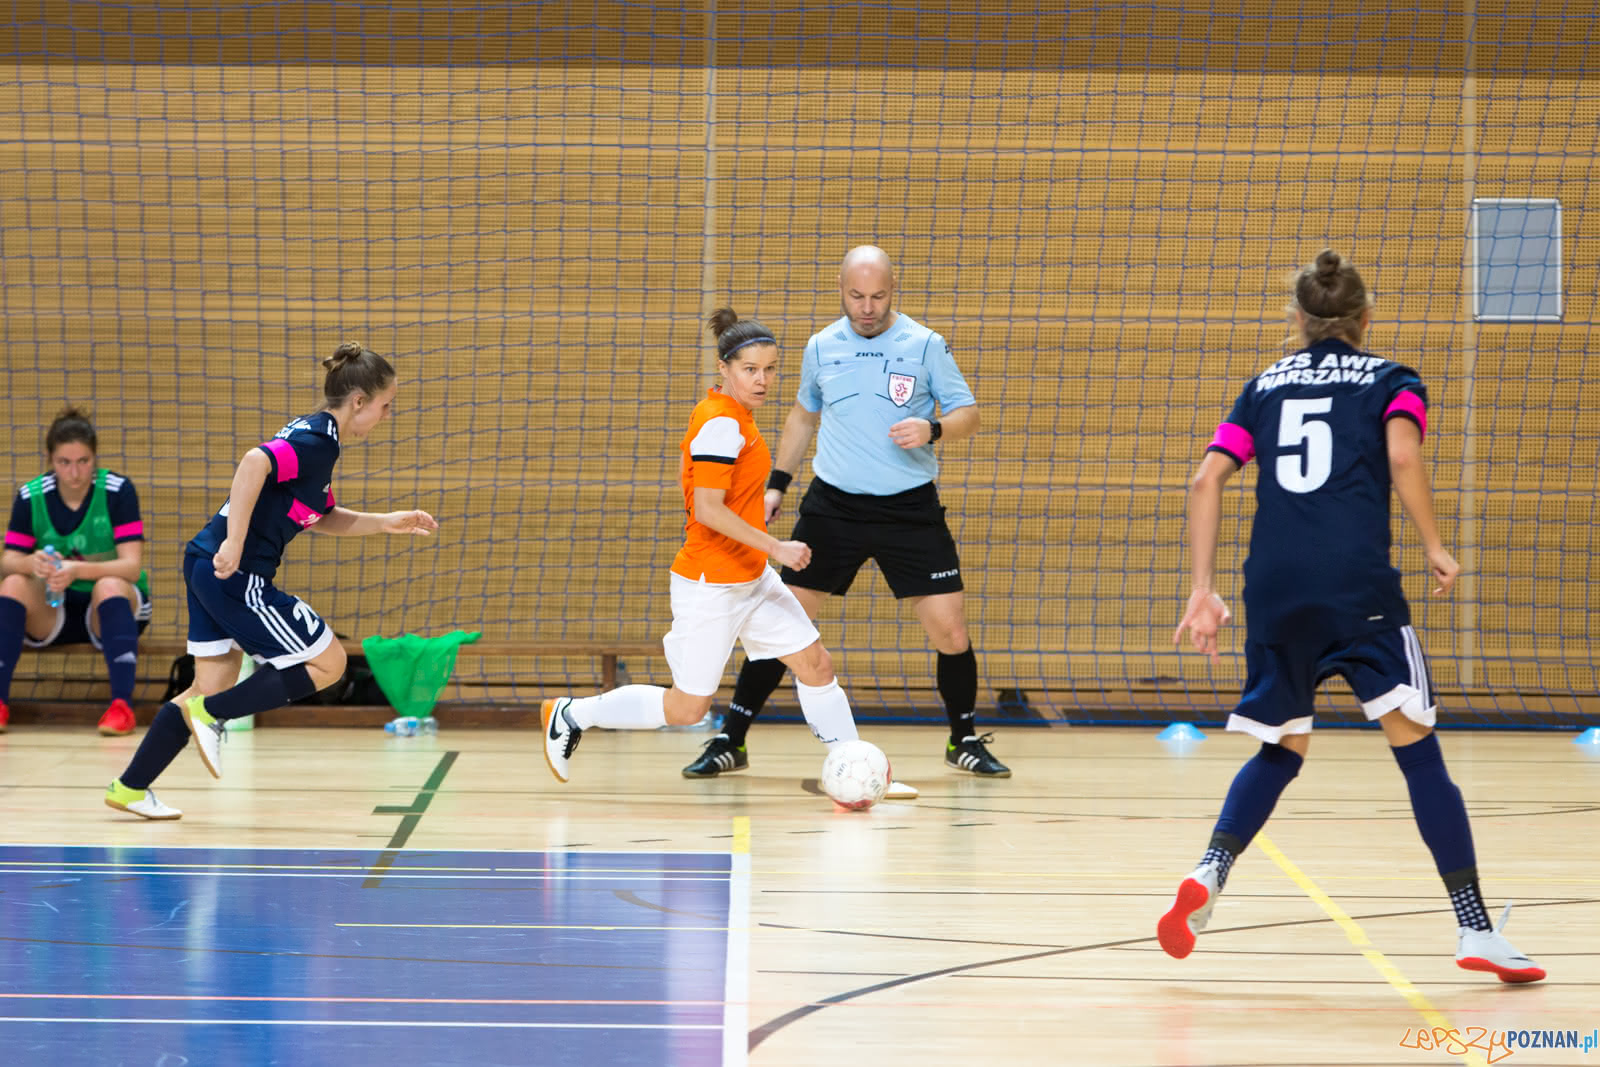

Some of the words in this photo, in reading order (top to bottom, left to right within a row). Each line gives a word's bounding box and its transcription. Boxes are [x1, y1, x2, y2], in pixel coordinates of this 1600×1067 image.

[1256, 368, 1376, 393] WARSZAWA
[1275, 397, 1333, 494] 5
[930, 569, 959, 579] zina
